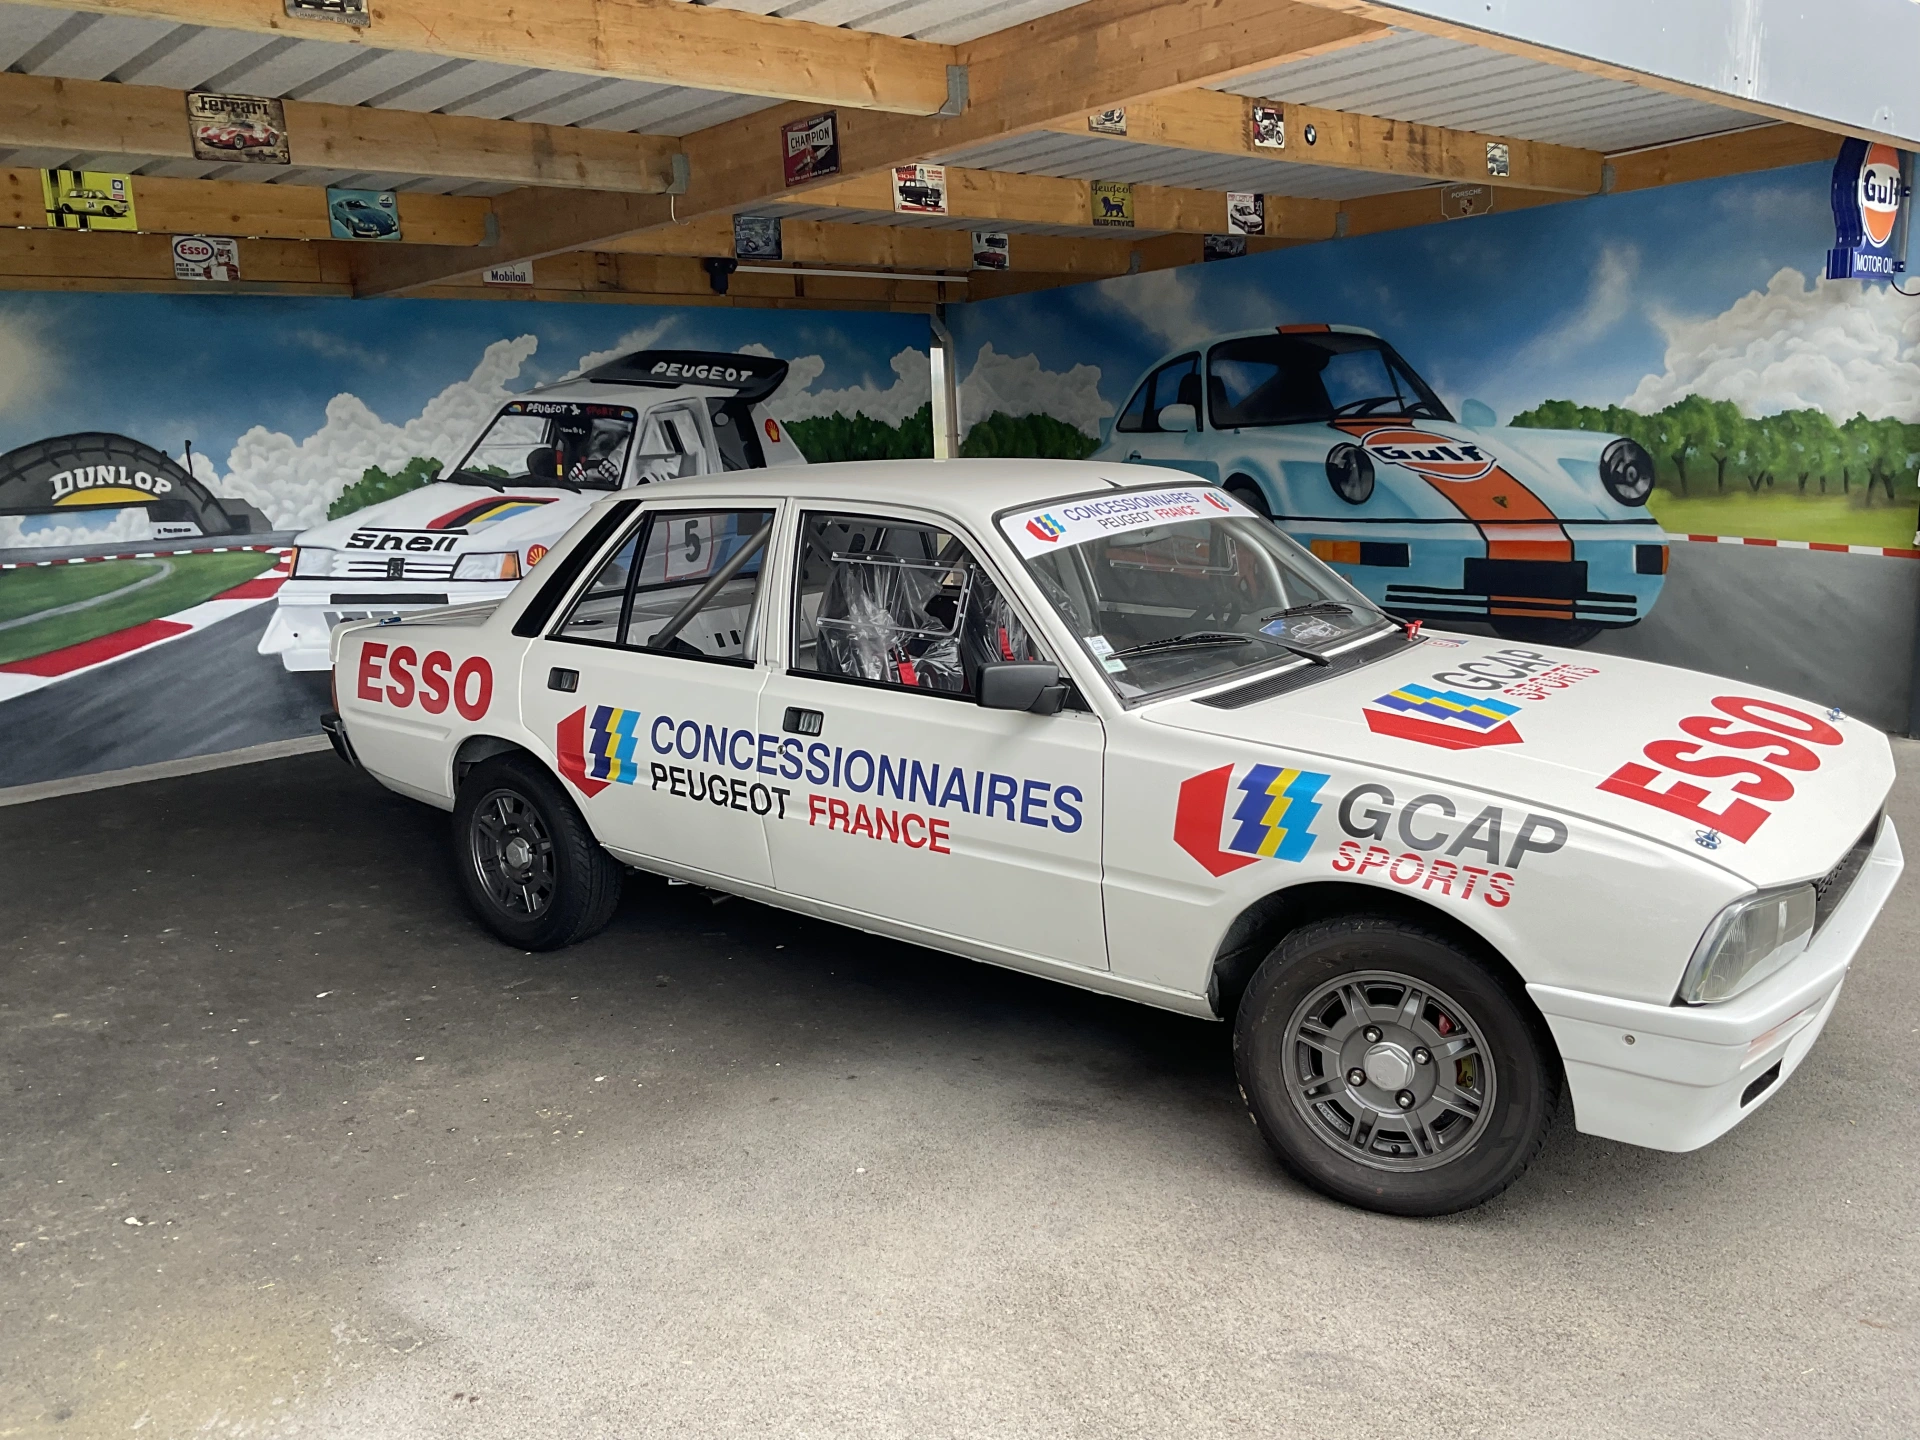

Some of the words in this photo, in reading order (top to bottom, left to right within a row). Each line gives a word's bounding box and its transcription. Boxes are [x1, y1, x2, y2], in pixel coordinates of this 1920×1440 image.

[198, 95, 269, 115] Ferrari
[790, 127, 830, 149] CHAMPION
[1451, 187, 1482, 199] PORSCHE
[1864, 169, 1900, 206] Gulf
[491, 270, 526, 282] Mobiloil
[1856, 255, 1882, 272] MOTOR
[1883, 257, 1894, 274] OIL
[651, 361, 753, 382] PEUGEOT
[526, 403, 568, 414] PEUGEOT
[1371, 446, 1483, 462] Gulf
[49, 465, 172, 500] DUNLOP
[1063, 491, 1200, 521] CONCESSIONNAIRES
[1096, 511, 1156, 530] PEUGEOT
[1155, 504, 1201, 520] FRANCE
[345, 532, 459, 552] Shell
[684, 519, 701, 563] 5
[358, 641, 493, 721] ESSO
[1432, 649, 1558, 691] GCAP
[1503, 664, 1600, 700] SPORTS
[650, 716, 1083, 834] CONCESSIONNAIRES
[1595, 696, 1843, 844] ESSO
[650, 762, 790, 819] PEUGEOT
[809, 794, 950, 855] FRANCE
[1337, 783, 1568, 870] GCAP
[1332, 840, 1515, 908] SPORTS
